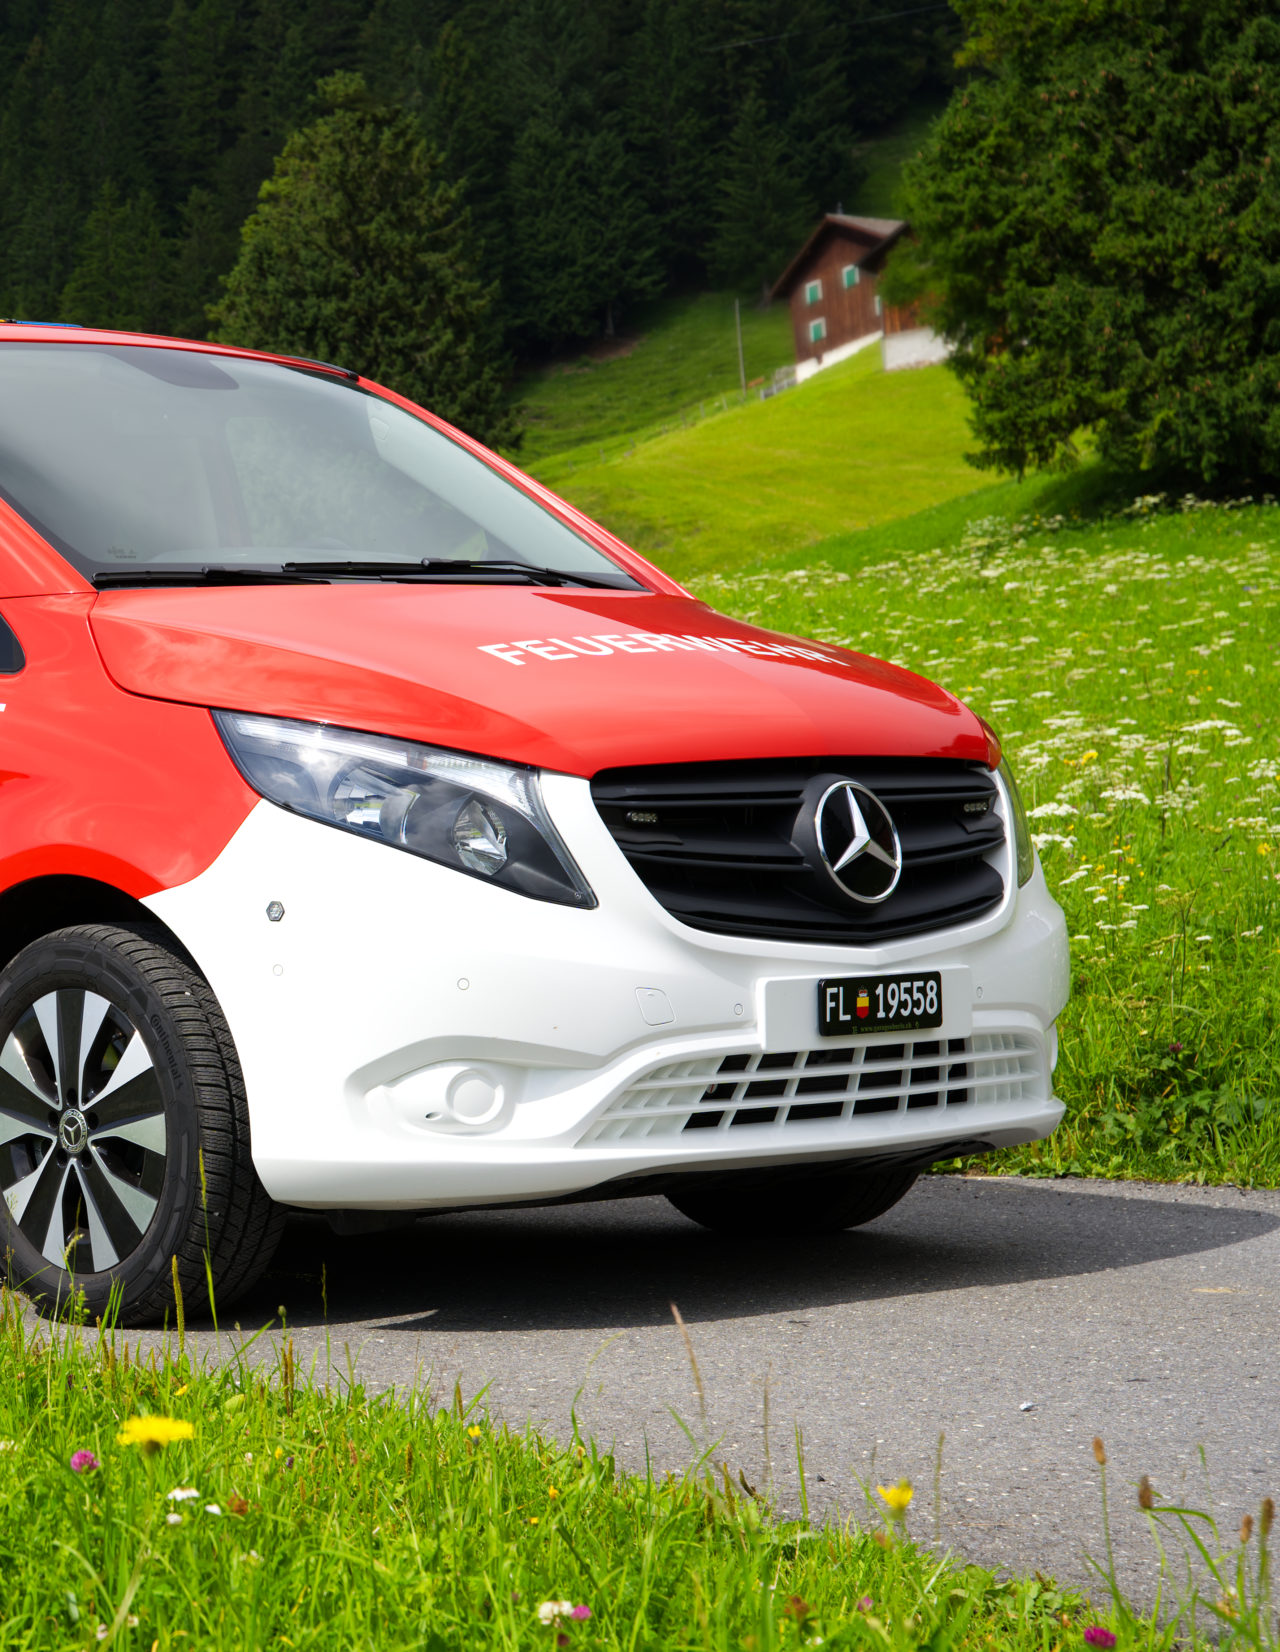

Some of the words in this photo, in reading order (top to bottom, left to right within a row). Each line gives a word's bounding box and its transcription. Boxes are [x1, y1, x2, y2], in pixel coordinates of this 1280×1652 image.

[476, 633, 852, 667] FEUERWEHR
[826, 986, 851, 1022] FL
[875, 980, 938, 1019] 19558
[151, 1014, 182, 1081] Continental
